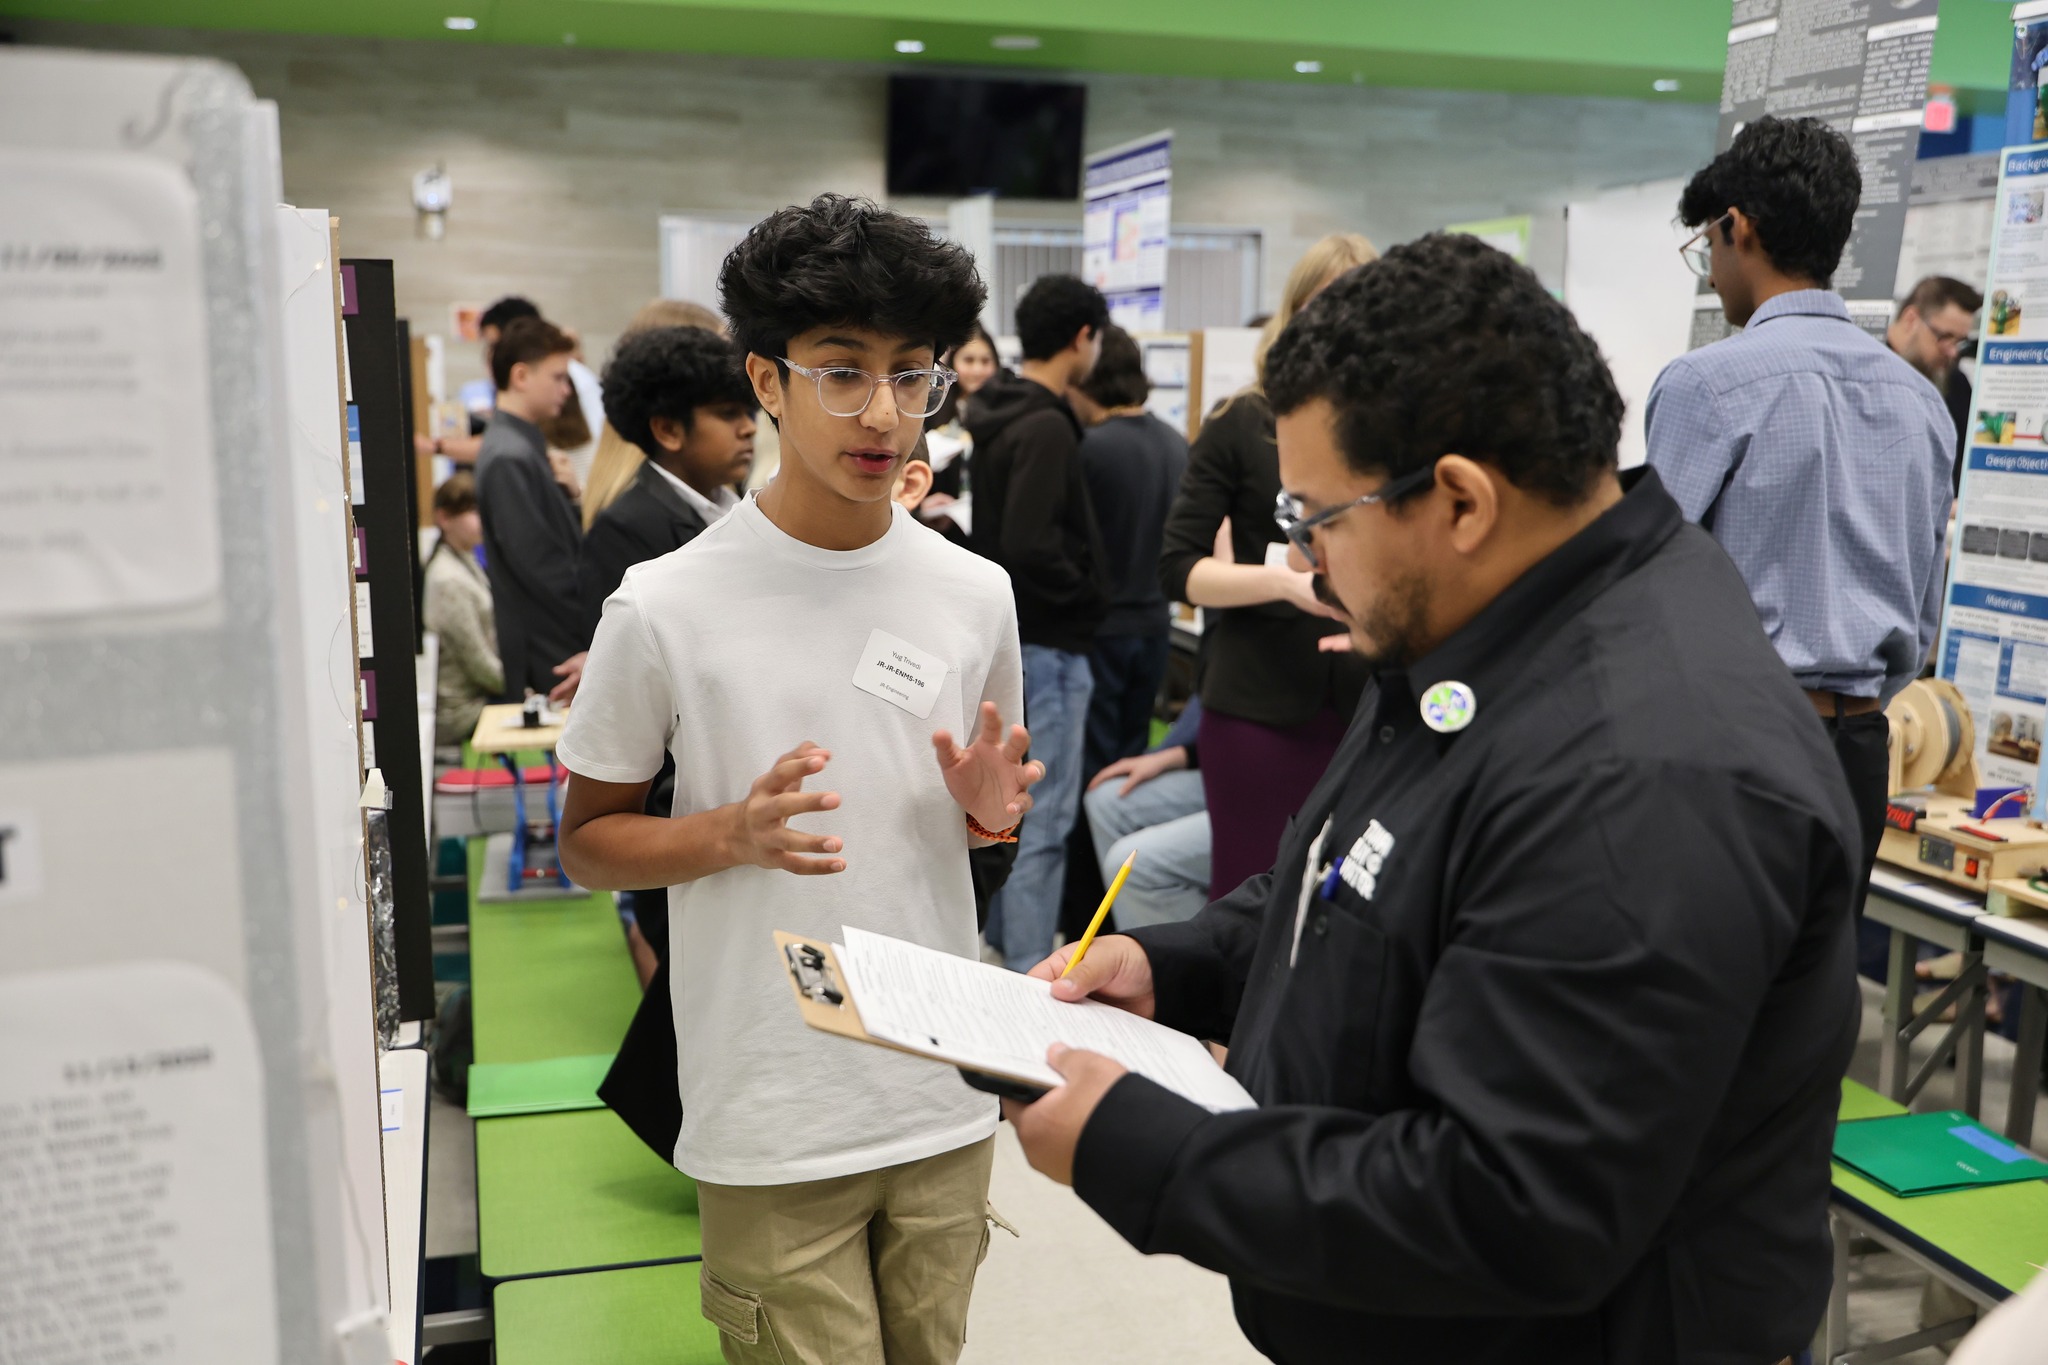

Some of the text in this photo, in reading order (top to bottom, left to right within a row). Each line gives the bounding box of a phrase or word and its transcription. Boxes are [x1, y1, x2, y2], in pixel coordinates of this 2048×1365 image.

[1989, 347, 2043, 363] Engineering
[1985, 453, 2016, 471] Design
[1985, 594, 2026, 611] Materials
[892, 651, 922, 670] Yug Trivedi
[876, 660, 925, 688] JR-JR-ENMS-196
[879, 682, 909, 700] JR-Engineering
